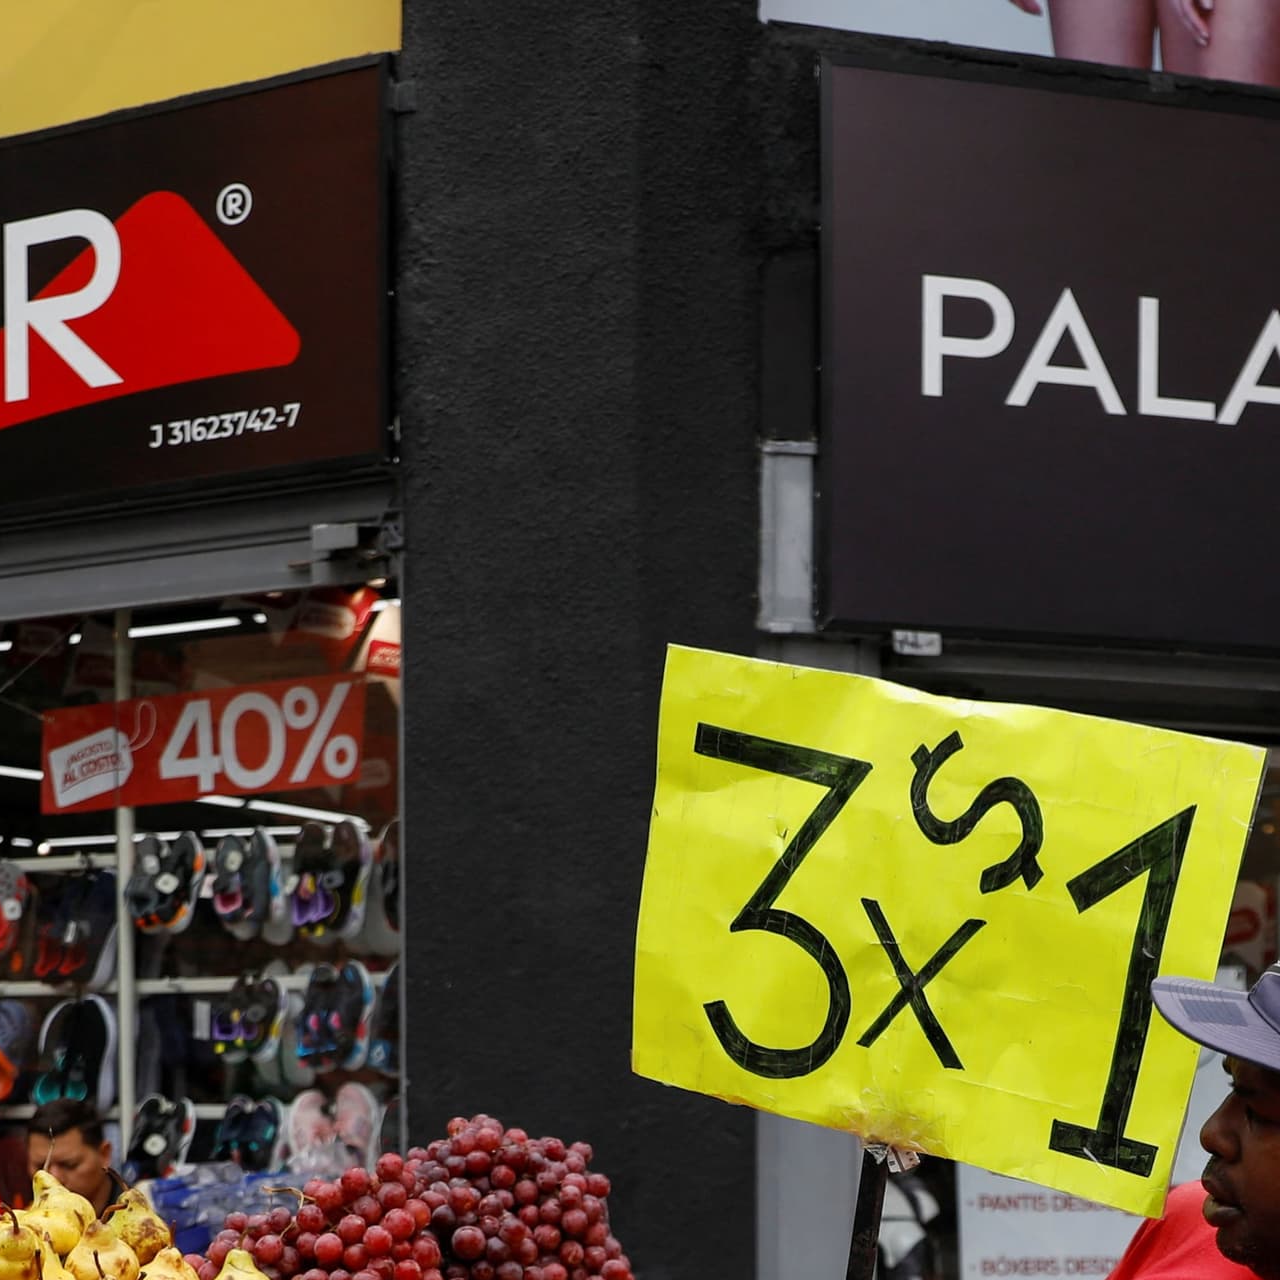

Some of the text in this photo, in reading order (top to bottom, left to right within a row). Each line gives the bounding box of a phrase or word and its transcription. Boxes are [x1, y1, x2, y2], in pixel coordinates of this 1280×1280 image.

[149, 402, 301, 449] J 31623742-7
[158, 681, 359, 793] 40%
[694, 723, 872, 1079] 3
[1048, 805, 1197, 1178] 1
[1065, 1257, 1119, 1276] DESD
